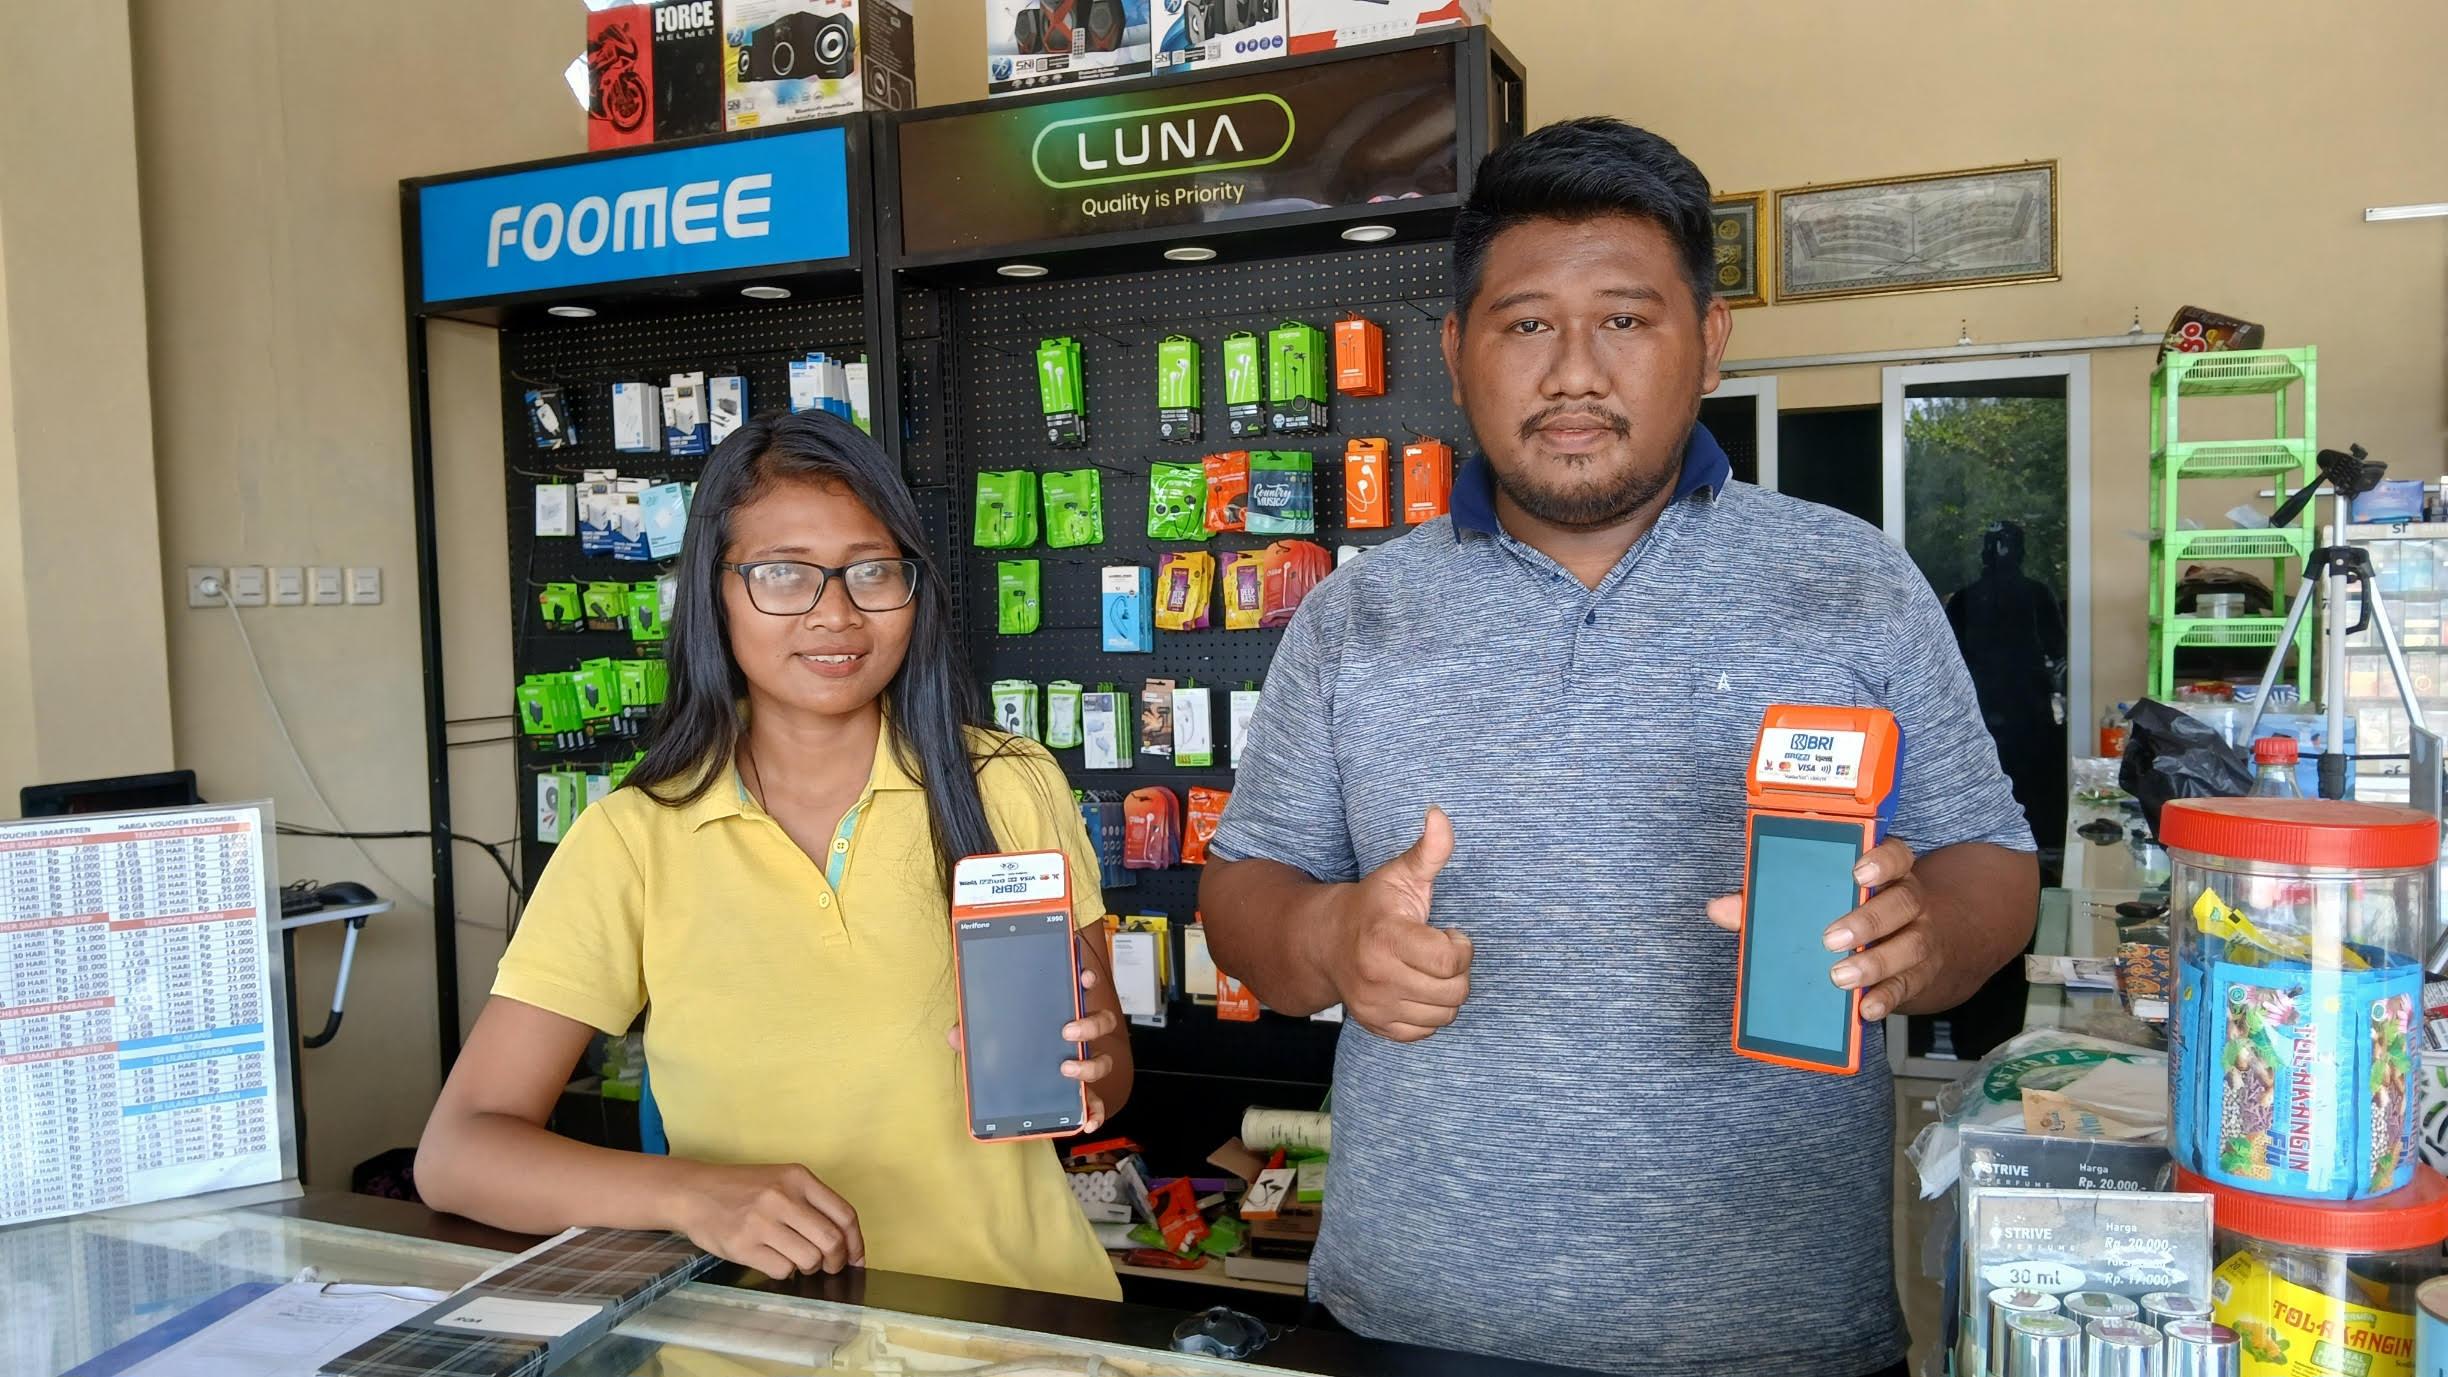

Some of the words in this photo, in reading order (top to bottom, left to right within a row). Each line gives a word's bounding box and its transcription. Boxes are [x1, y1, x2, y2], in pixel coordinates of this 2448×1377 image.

[655, 1, 714, 33] FORCE
[655, 28, 715, 42] HELMET
[1078, 114, 1244, 171] LUNA
[1082, 193, 1151, 218] Quality
[1155, 189, 1170, 208] is
[1175, 182, 1245, 205] Priority
[487, 173, 773, 268] FOOMEE
[1254, 483, 1292, 505] Country
[1807, 735, 1835, 751] BRI
[1798, 763, 1816, 772] VISA
[150, 819, 189, 828] VOUCHER
[191, 816, 236, 824] TELKOMSEL
[40, 827, 90, 836] SMARTFREN
[960, 922, 990, 930] Verifone
[2265, 1130, 2287, 1168] Flu
[1985, 1162, 2029, 1177] STRIVE
[2079, 1162, 2109, 1175] Harga
[2078, 1177, 2096, 1190] Rp.
[2099, 1178, 2147, 1192] 20.000,-
[2004, 1227, 2052, 1240] STRIVE
[2106, 1222, 2138, 1234] Harga
[2010, 1269, 2031, 1285] 30
[2037, 1269, 2061, 1285] ml
[2104, 1273, 2124, 1287] Rp.
